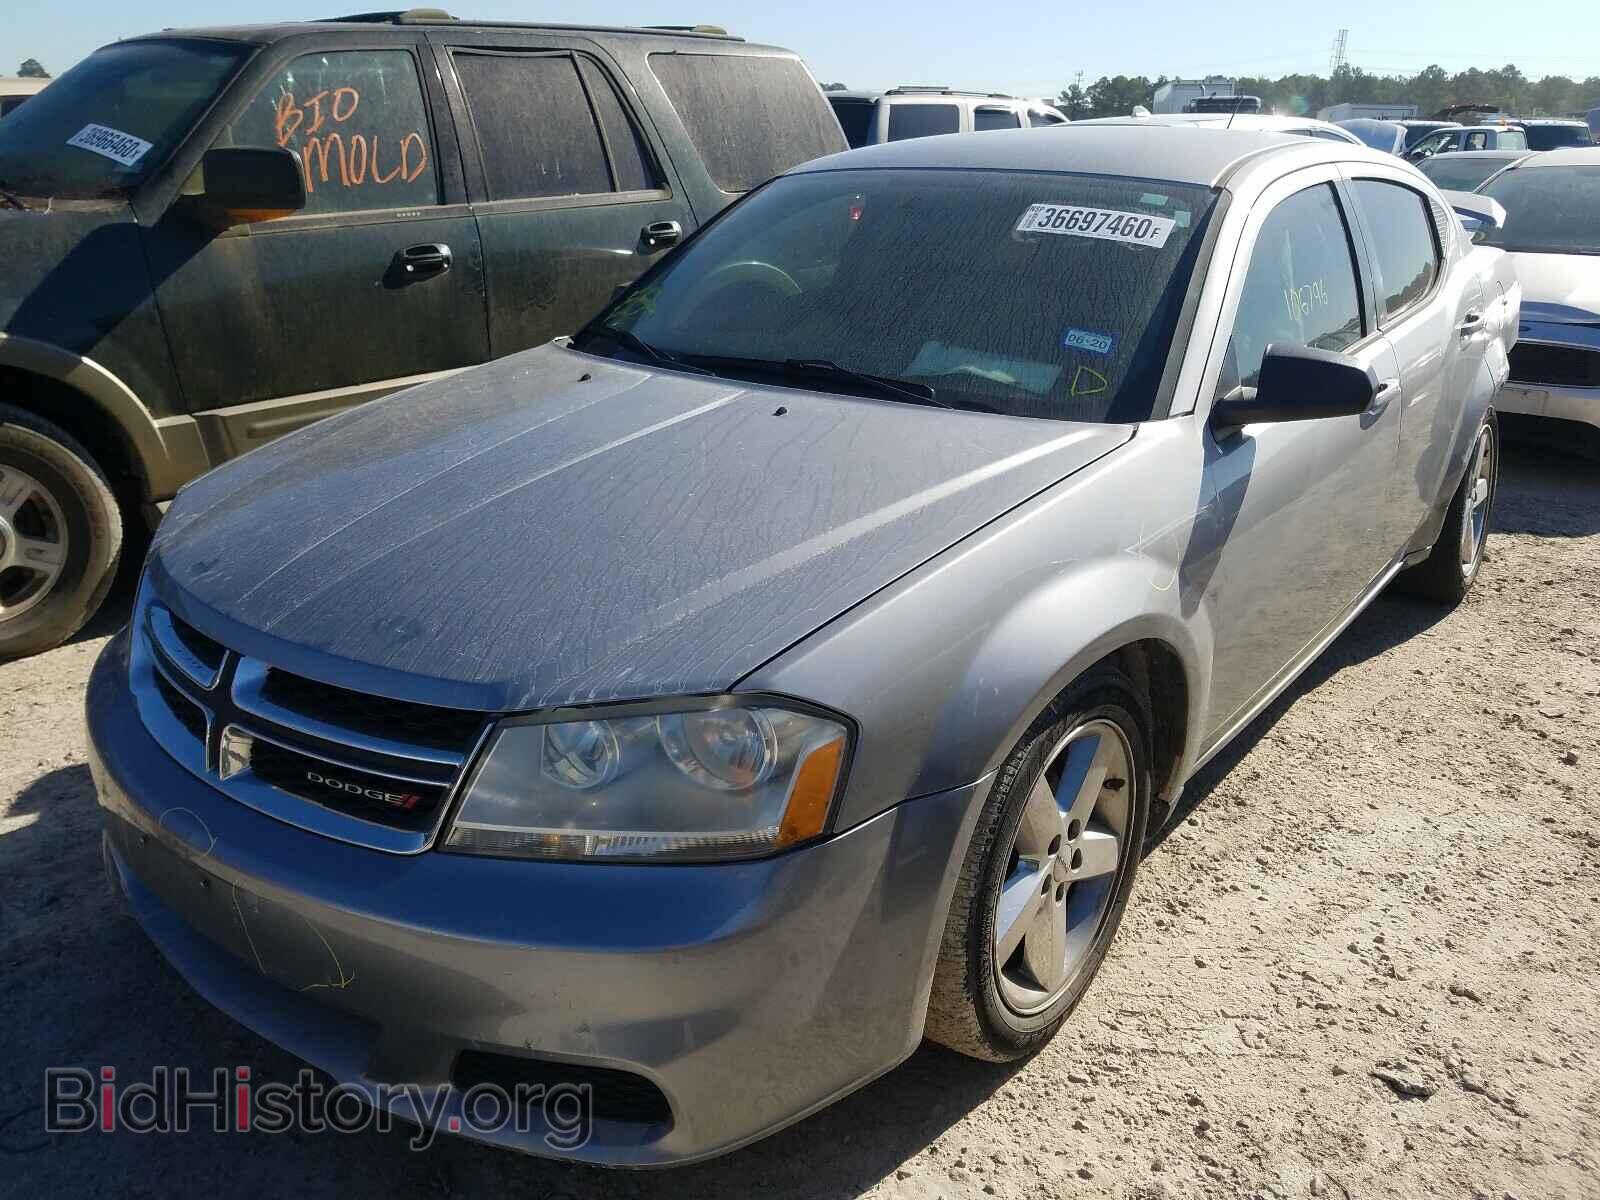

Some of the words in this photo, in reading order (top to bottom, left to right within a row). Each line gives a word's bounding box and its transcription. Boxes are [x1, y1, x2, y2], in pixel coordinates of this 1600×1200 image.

[274, 87, 360, 148] BIO
[303, 132, 429, 193] MOLD
[307, 771, 403, 806] DODGE
